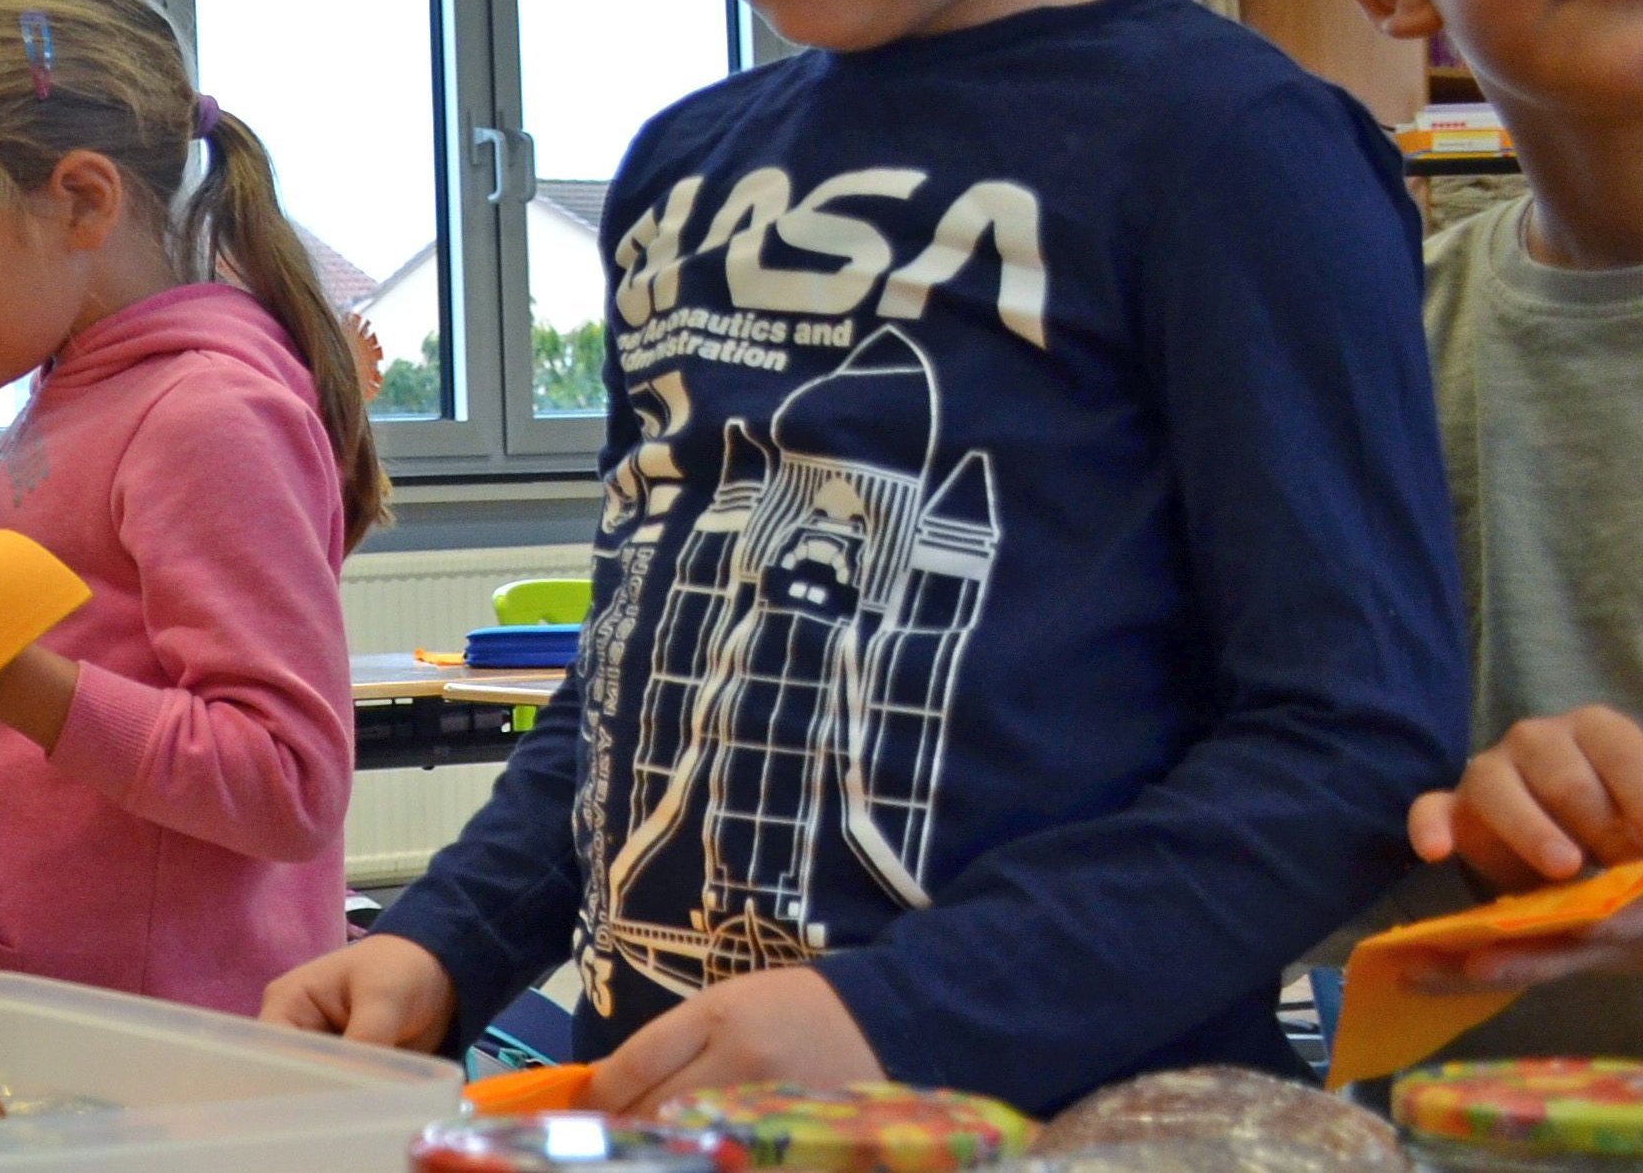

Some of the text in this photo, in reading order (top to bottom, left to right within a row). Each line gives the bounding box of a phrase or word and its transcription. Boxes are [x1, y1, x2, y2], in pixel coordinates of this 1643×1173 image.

[615, 166, 1048, 351] NASA
[793, 317, 854, 348] and
[603, 545, 656, 717] MISSION
